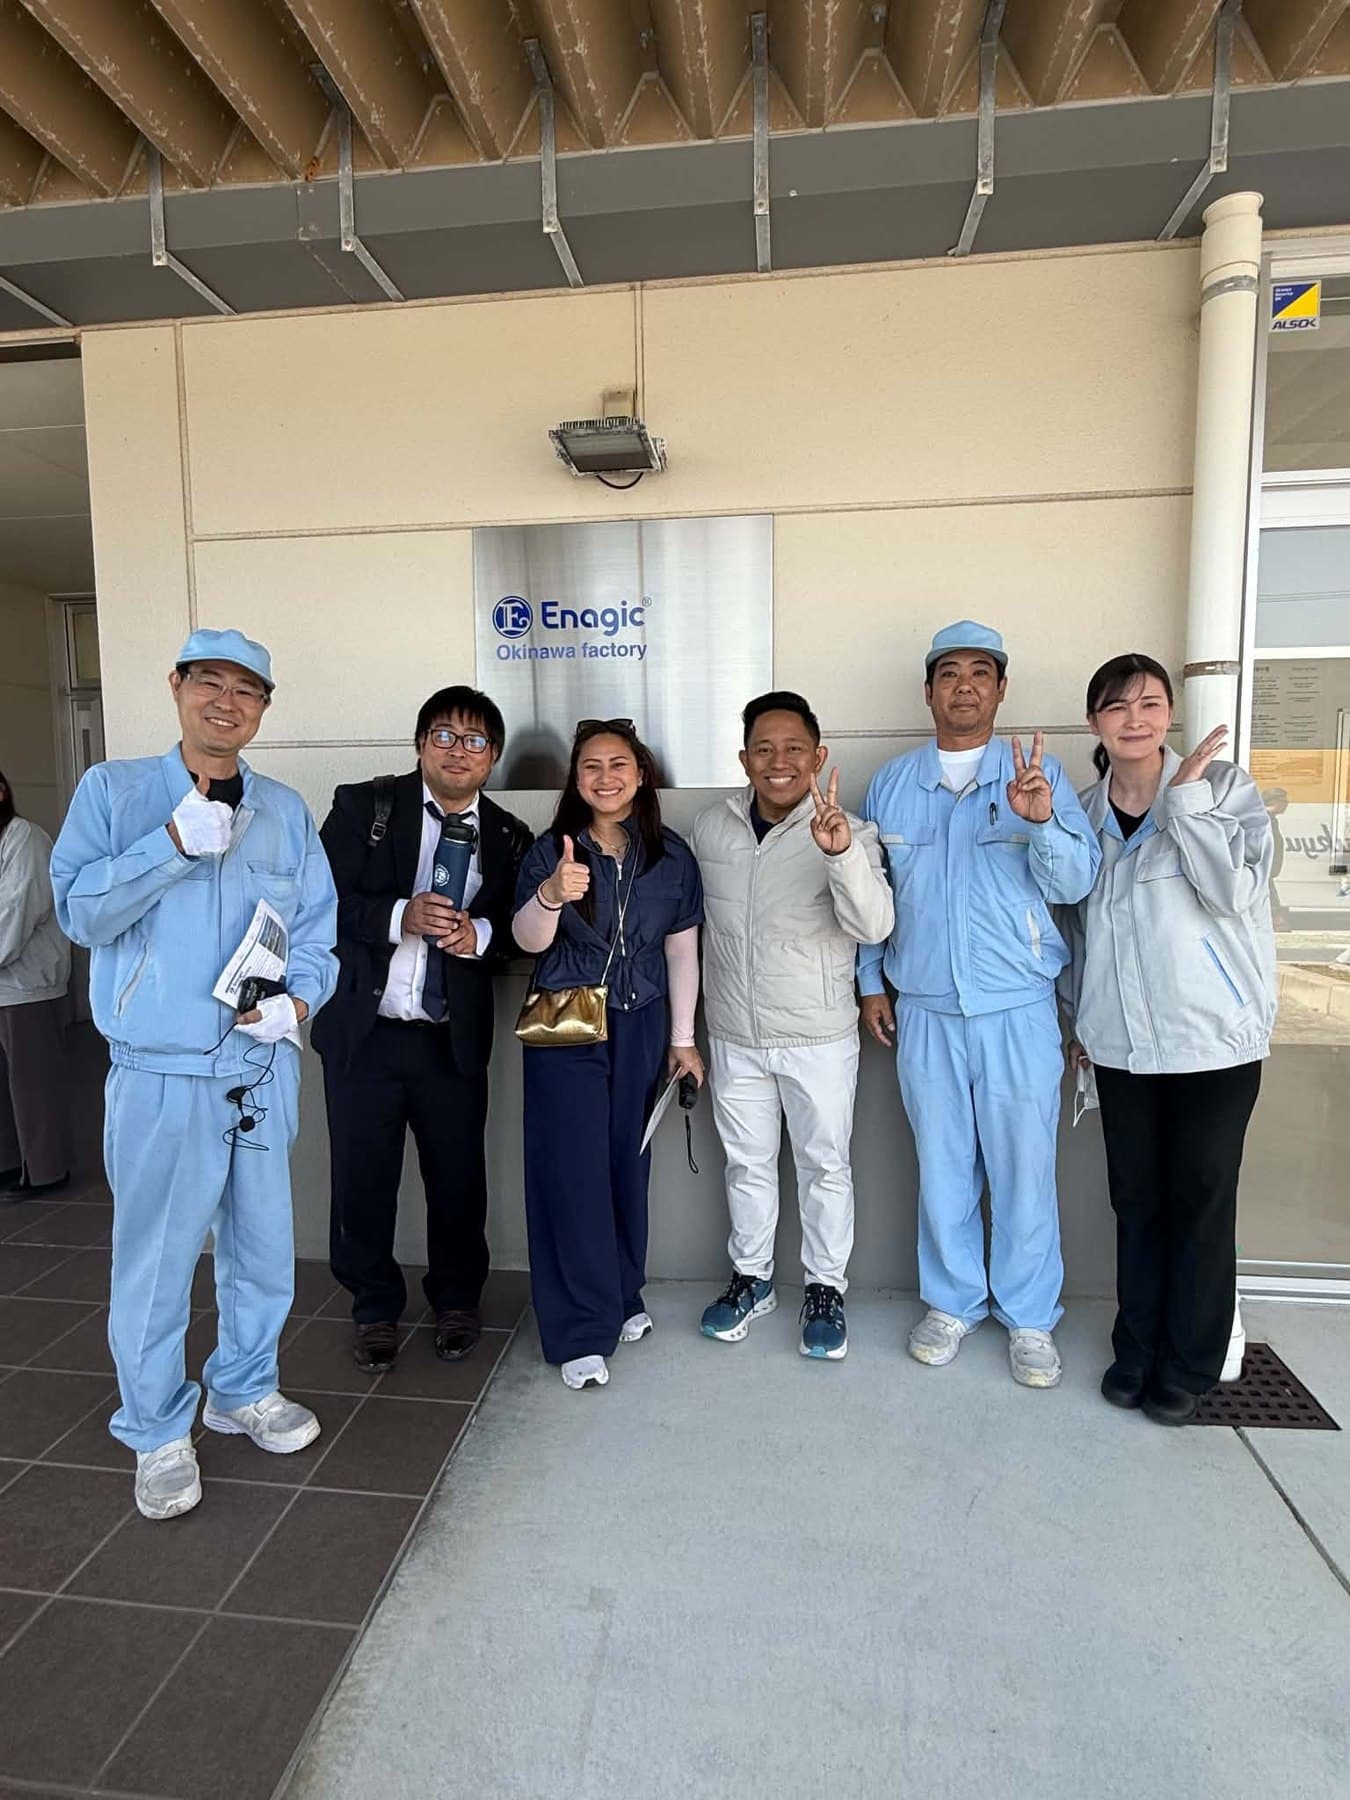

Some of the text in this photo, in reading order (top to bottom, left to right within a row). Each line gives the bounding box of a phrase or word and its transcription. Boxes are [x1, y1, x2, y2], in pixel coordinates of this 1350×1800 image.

[1272, 319, 1317, 330] ALSOK
[496, 642, 648, 661] Okinawa factory
